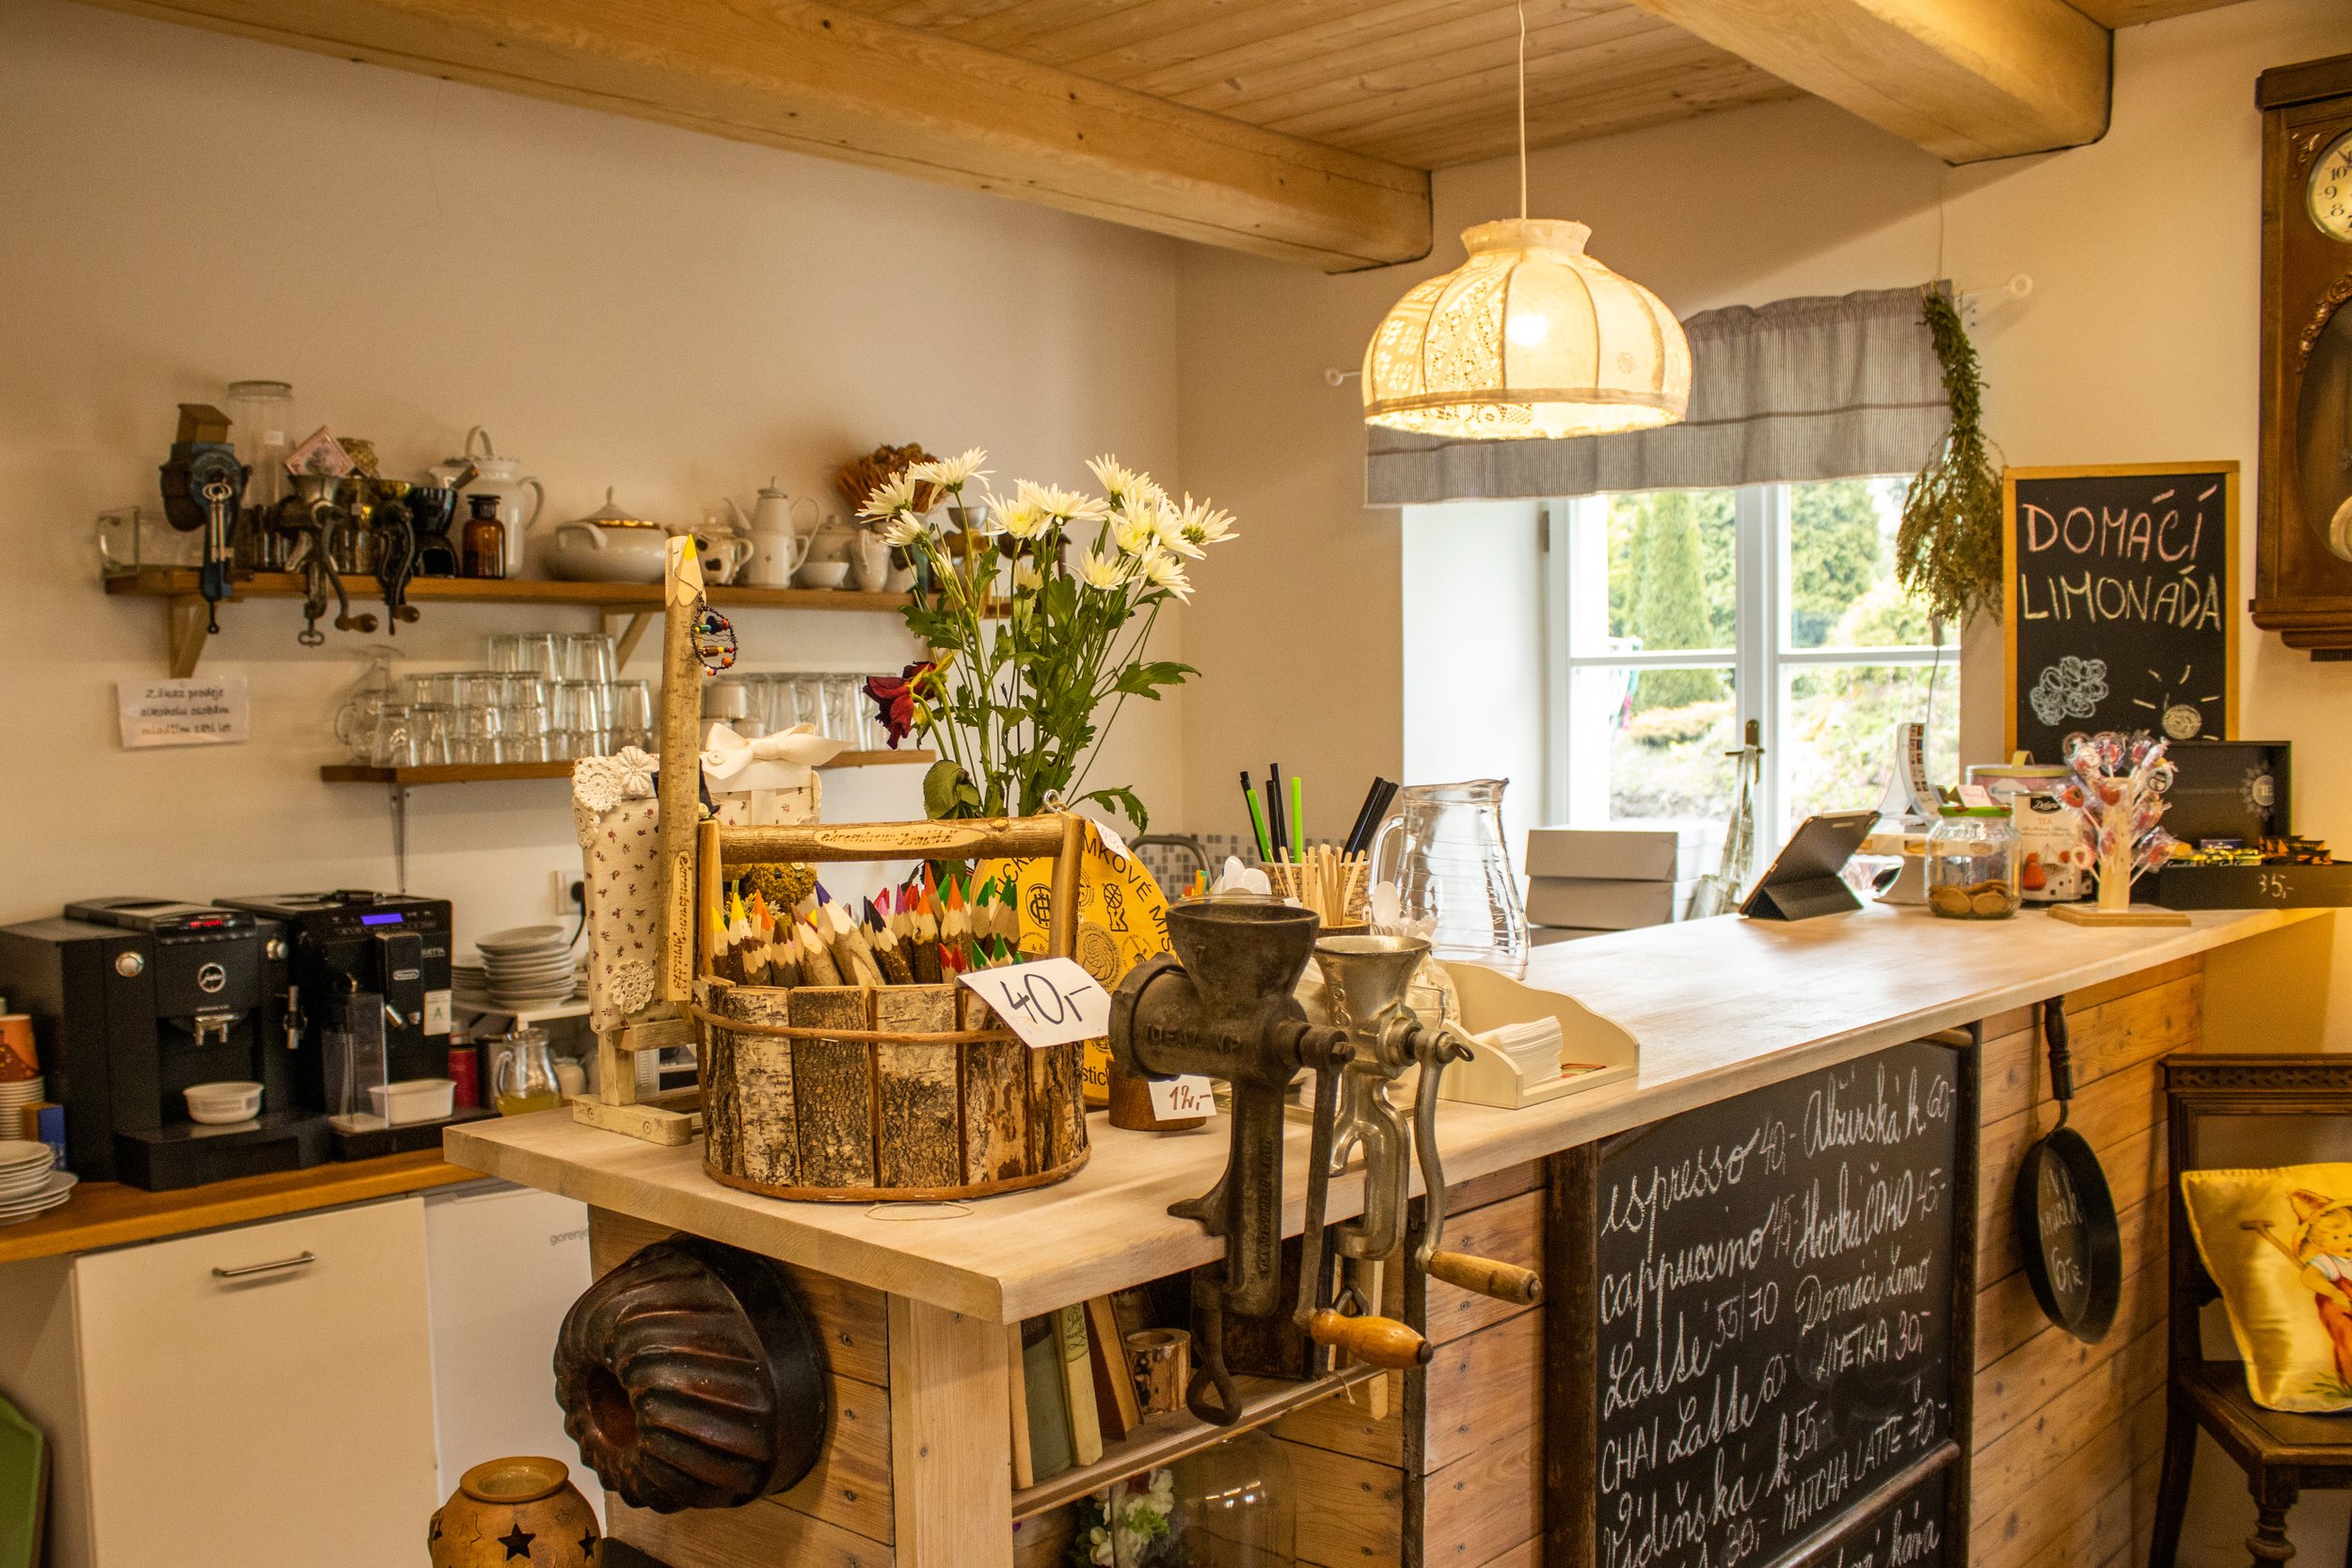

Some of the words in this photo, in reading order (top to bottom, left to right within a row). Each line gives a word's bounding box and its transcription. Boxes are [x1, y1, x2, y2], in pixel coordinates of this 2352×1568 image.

[2324, 185, 2338, 200] 9
[2330, 203, 2344, 217] 8
[2331, 166, 2347, 181] 10
[2022, 484, 2217, 563] DOMÁCÍ
[2022, 565, 2221, 631] LIMONÁDA
[1084, 833, 1152, 902] MKOVÉ
[1000, 974, 1091, 1025] 40,-
[1168, 1085, 1212, 1111] 12,-
[1804, 1061, 1900, 1159] Alžírská
[1600, 1128, 1760, 1263] espresso
[1793, 1162, 1863, 1269] Horká
[1865, 1161, 1915, 1244] ČOKO
[1601, 1202, 1775, 1345] cappuccino
[1795, 1249, 1883, 1336] Domácí
[1604, 1312, 1714, 1421] Latte
[1602, 1417, 1659, 1495] CHAI
[1781, 1450, 1849, 1536] MATCHA
[1853, 1415, 1903, 1481] LATTE
